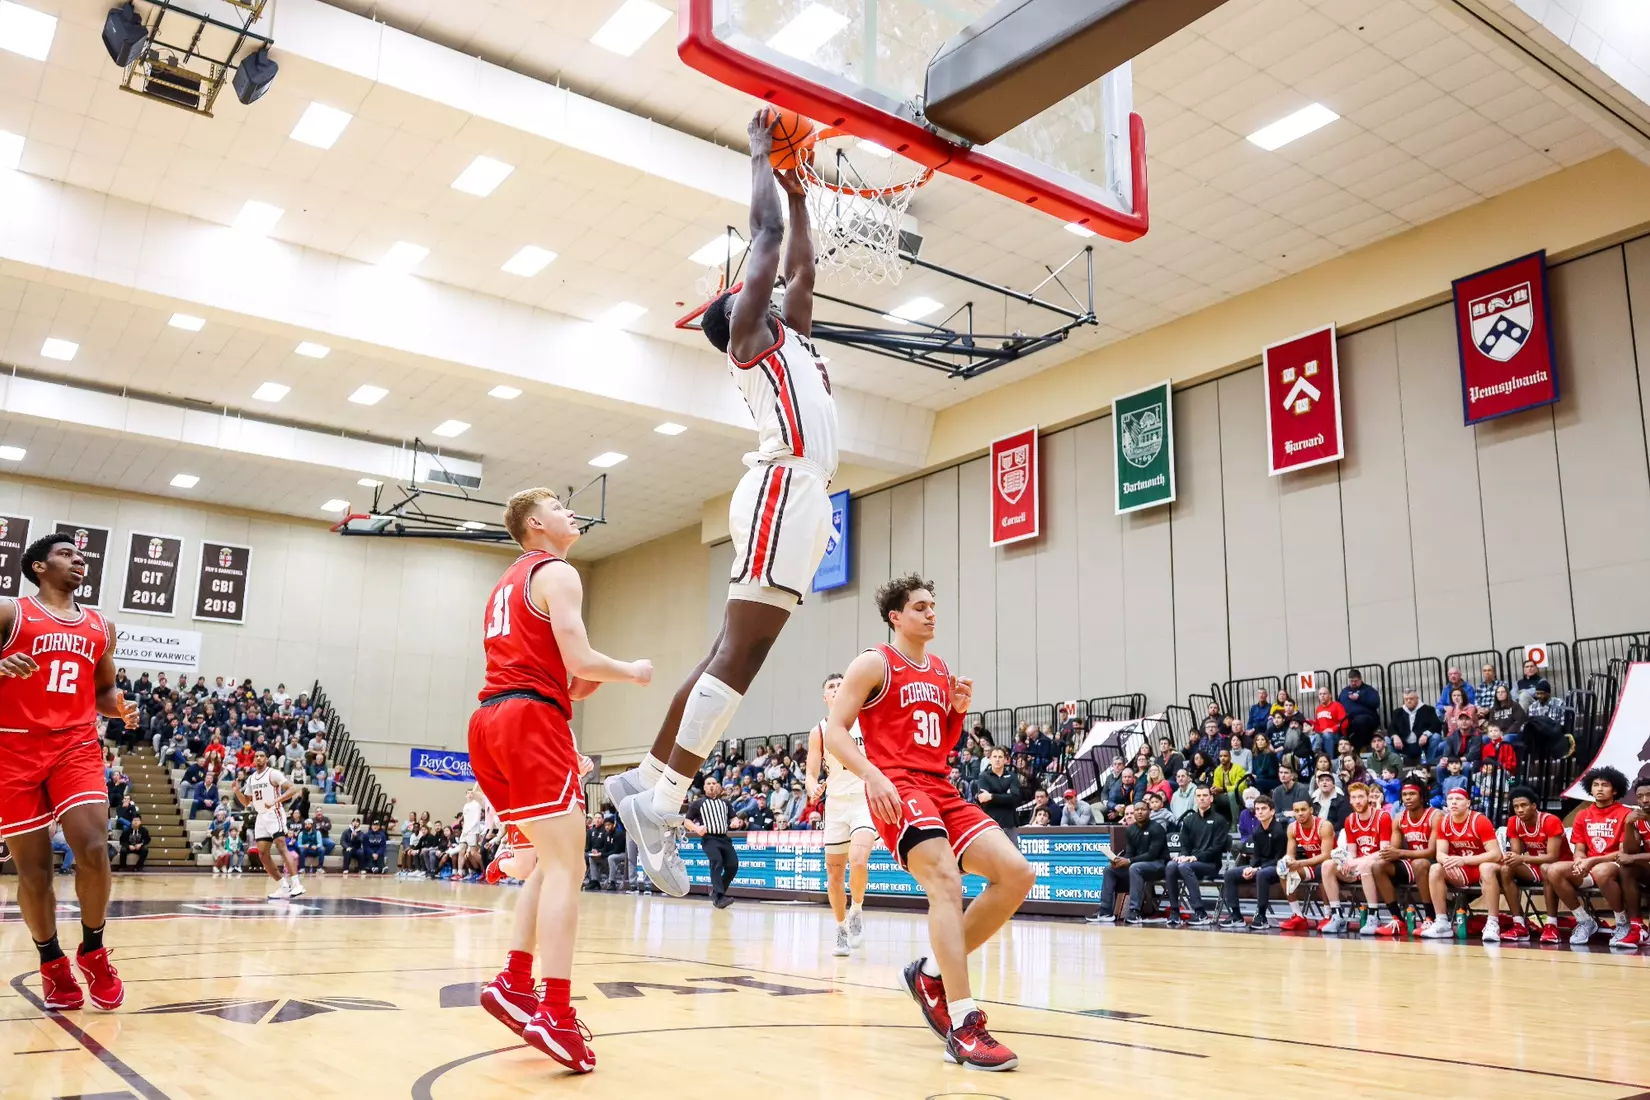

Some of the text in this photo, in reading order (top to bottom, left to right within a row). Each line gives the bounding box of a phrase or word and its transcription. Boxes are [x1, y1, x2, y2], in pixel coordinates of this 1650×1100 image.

[1469, 370, 1548, 403] Pennsylvania
[1284, 432, 1325, 455] Harvard
[1123, 473, 1166, 494] Dartmouth
[1001, 511, 1026, 527] Cornell
[141, 570, 163, 585] CIT
[211, 579, 234, 594] CBI
[131, 589, 166, 606] 2014
[203, 597, 237, 613] 2019
[486, 584, 514, 639] 31
[132, 634, 180, 645] LEXUS
[32, 632, 96, 664] CORNELL
[114, 647, 196, 662] EXUS OF WARWICK
[1528, 647, 1545, 665] O
[46, 659, 79, 694] 12
[227, 678, 235, 687] J
[1300, 674, 1313, 689] N
[900, 681, 952, 716] CORNELL
[1066, 703, 1076, 715] M
[913, 710, 941, 748] 30
[419, 753, 472, 772] BayCoas
[254, 790, 263, 801] 21
[907, 798, 923, 817] C
[1021, 839, 1050, 854] STORE
[1054, 843, 1081, 852] SPORTS
[775, 859, 795, 871] TICKET
[802, 859, 821, 872] STORE
[866, 863, 890, 871] THEATER
[1055, 866, 1082, 875] SPORTS
[775, 877, 795, 889] TICKET
[801, 877, 821, 890] STORE
[890, 883, 911, 891] TICKETS
[1055, 889, 1082, 898] SPORTS
